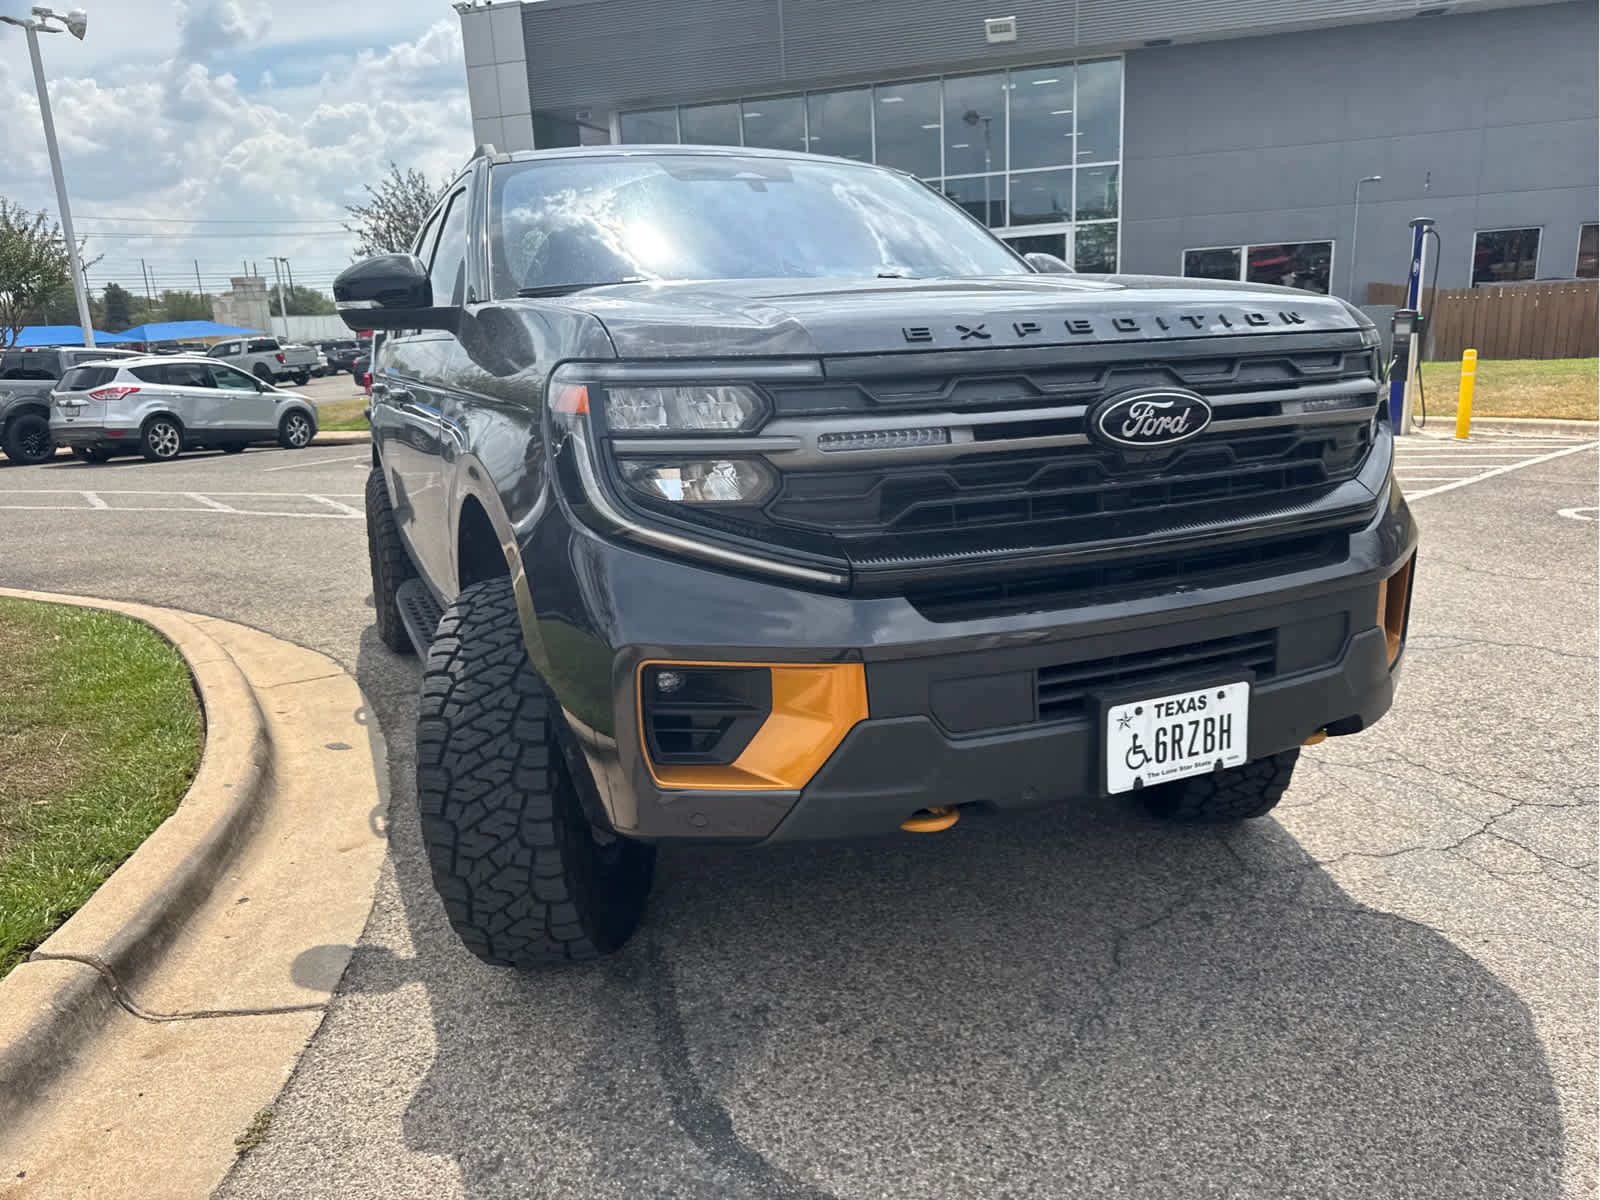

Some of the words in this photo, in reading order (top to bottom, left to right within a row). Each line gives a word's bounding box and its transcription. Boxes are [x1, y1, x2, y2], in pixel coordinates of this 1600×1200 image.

[902, 311, 1307, 343] EXPEDITION
[1122, 401, 1192, 437] Ford
[1154, 695, 1207, 719] TEXAS
[1155, 713, 1232, 764] 6RZBH
[1147, 771, 1160, 779] The
[1161, 767, 1178, 776] Lone
[1179, 764, 1193, 772] Star
[1194, 760, 1212, 769] State
